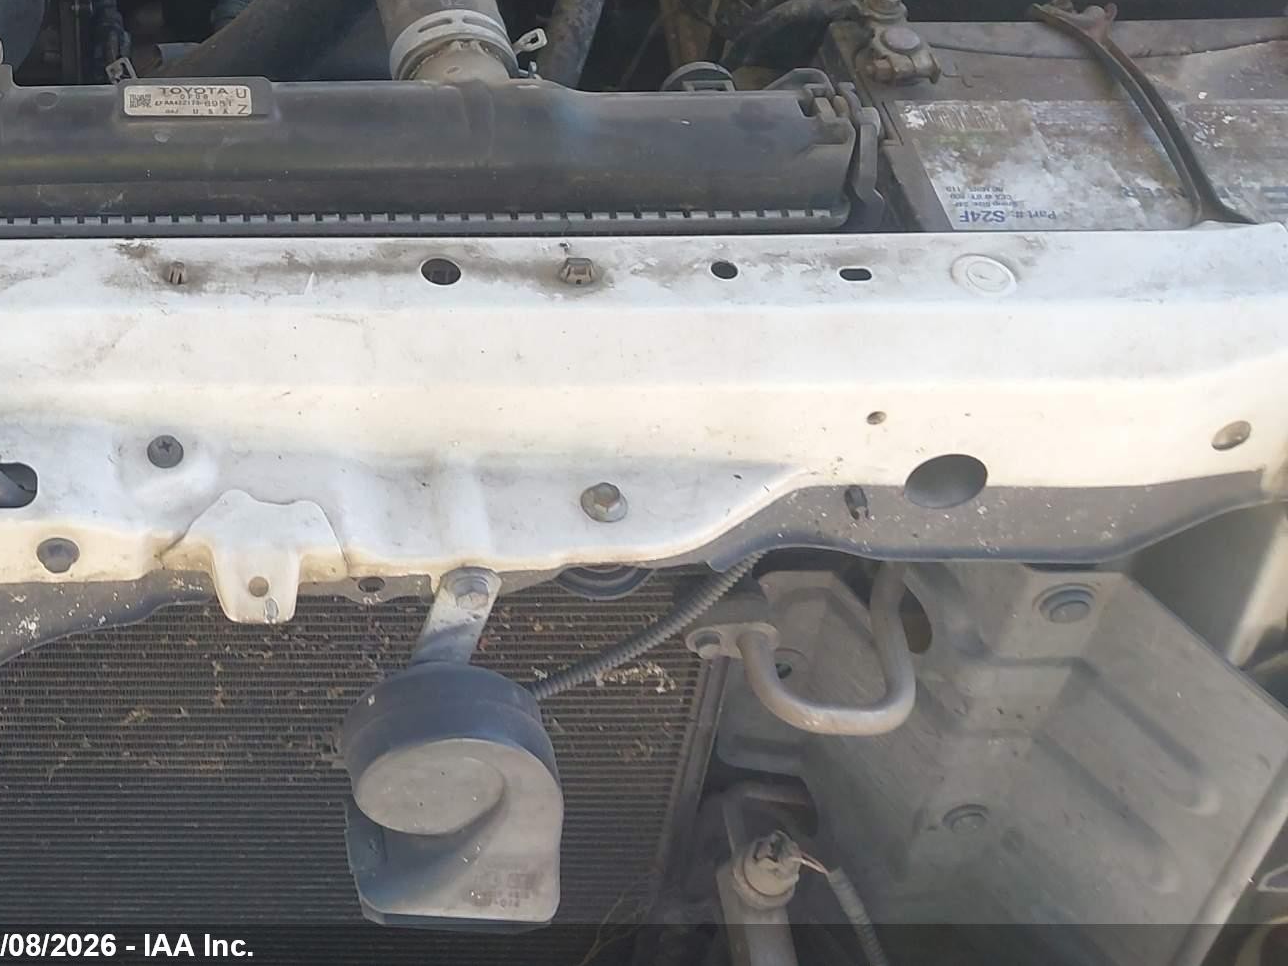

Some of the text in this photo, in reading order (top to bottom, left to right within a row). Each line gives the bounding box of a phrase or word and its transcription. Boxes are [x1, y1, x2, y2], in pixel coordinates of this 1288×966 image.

[160, 87, 228, 95] TOYOTA
[959, 210, 1006, 223] S24F
[1028, 211, 1057, 219] Part
